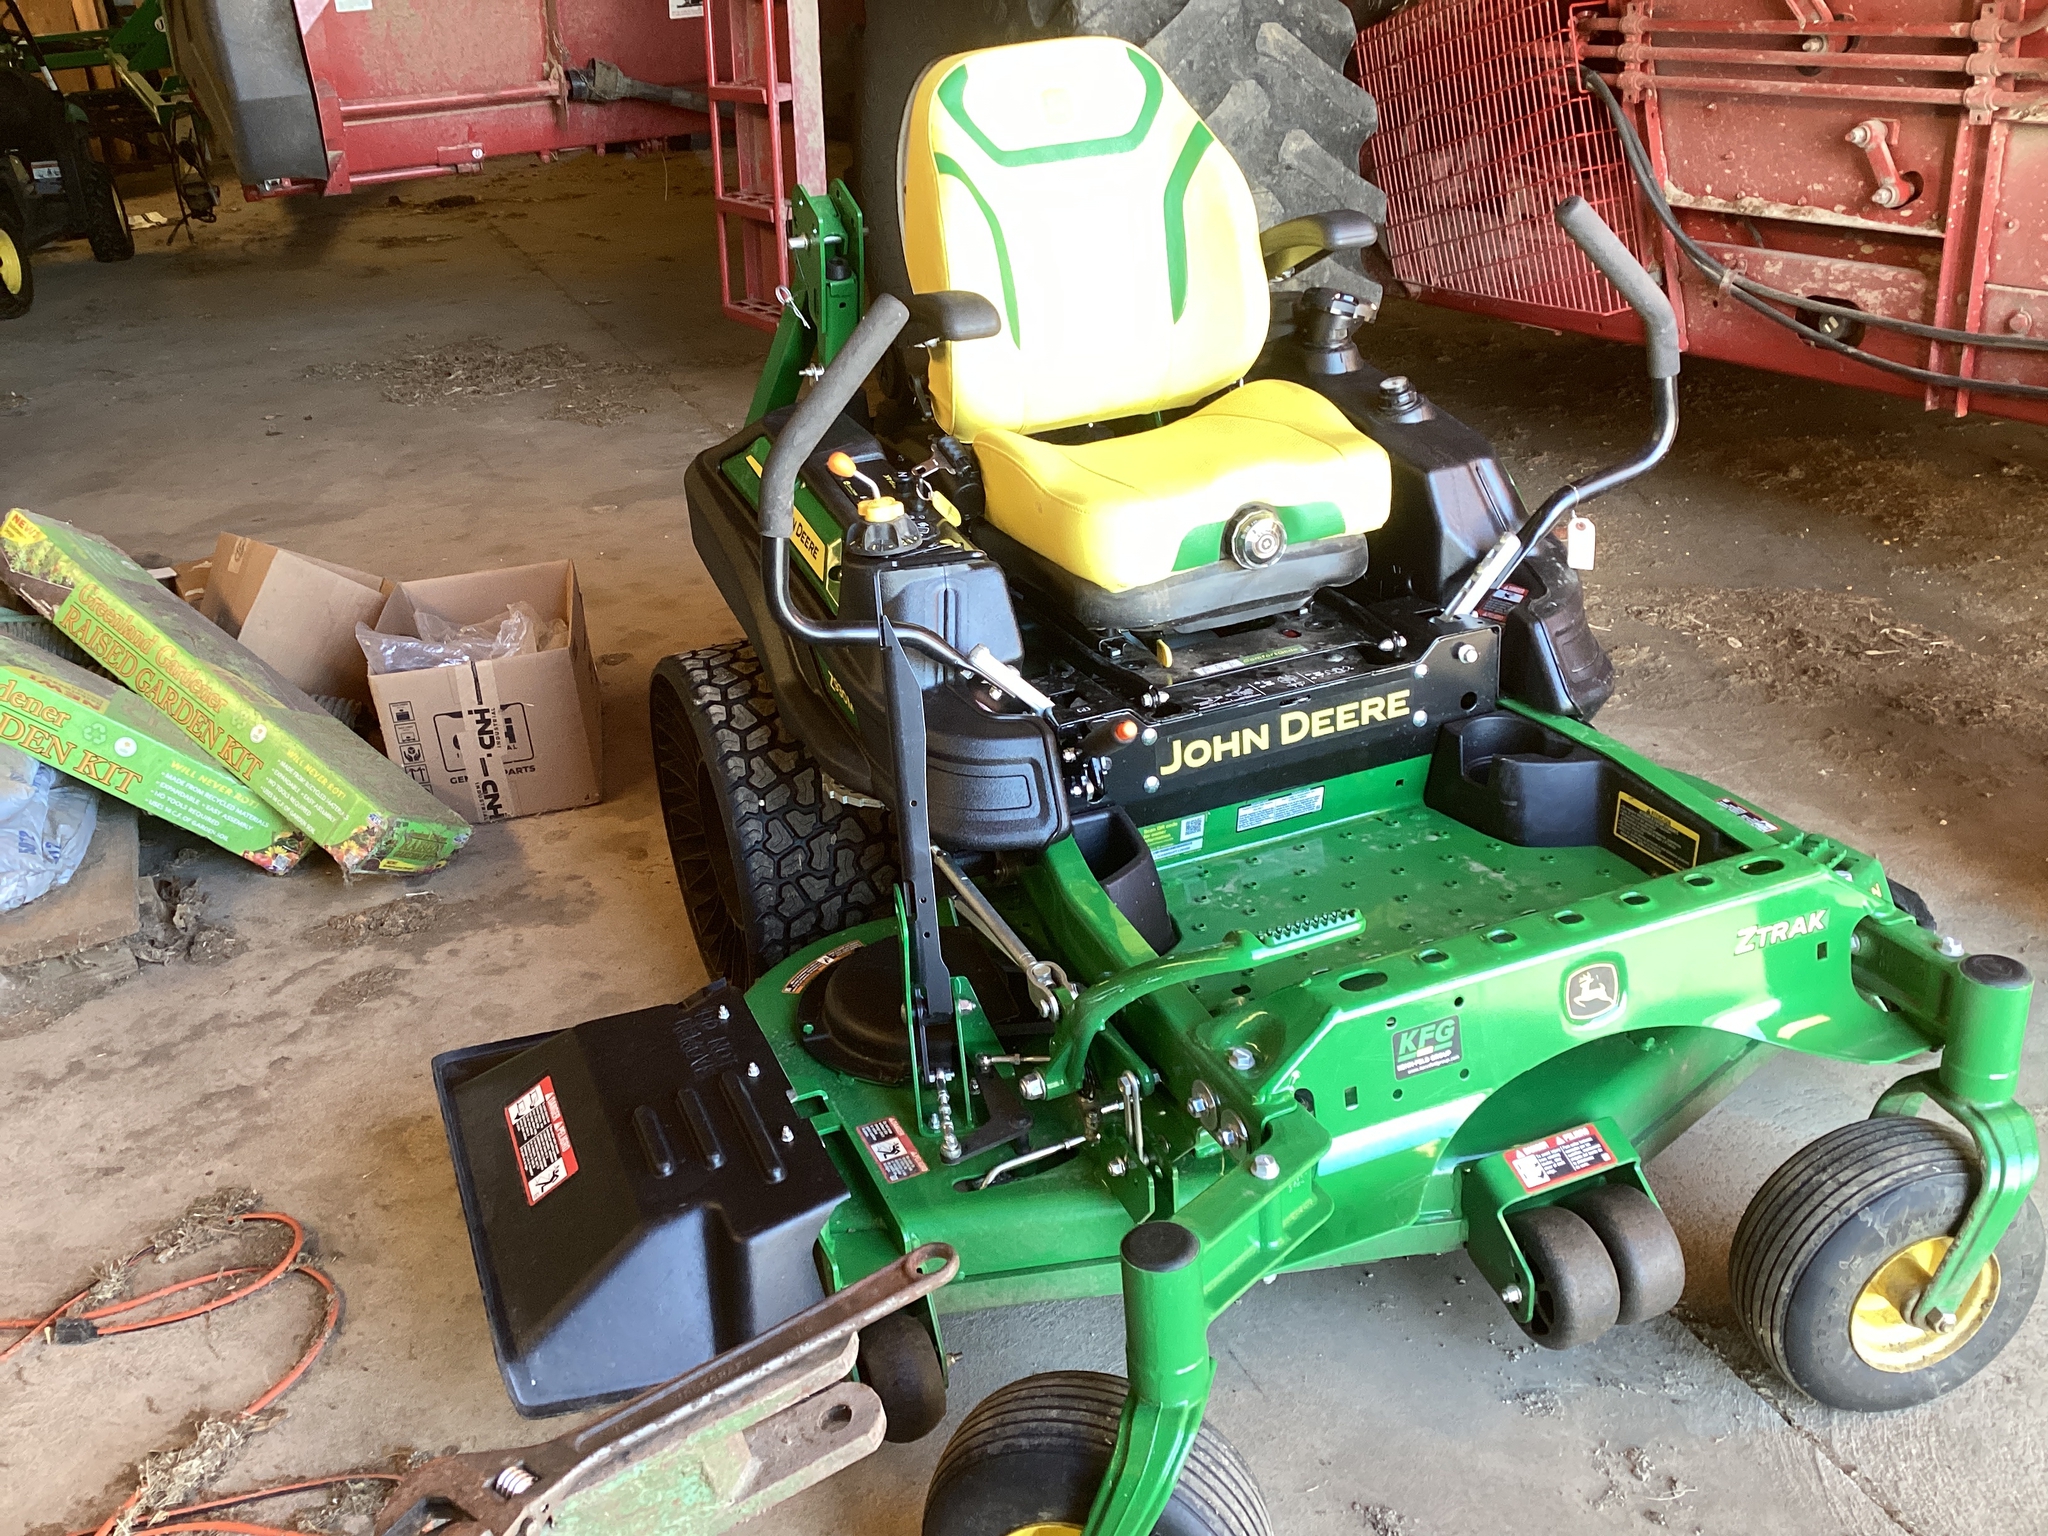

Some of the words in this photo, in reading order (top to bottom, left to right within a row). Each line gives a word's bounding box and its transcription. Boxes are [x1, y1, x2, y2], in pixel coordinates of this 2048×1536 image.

[795, 522, 820, 560] DEERE
[78, 583, 159, 655] Greenland
[155, 645, 228, 713] Gardener
[59, 604, 139, 677] RAISED
[135, 668, 224, 750] GARDEN
[217, 735, 264, 781] KIT
[473, 708, 495, 749] CNH
[491, 707, 501, 748] INDUSTRIAL
[1159, 723, 1270, 776] JOHN
[1280, 688, 1411, 745] DEERE
[73, 750, 143, 794] KIT
[171, 760, 197, 779] WILL
[198, 774, 233, 796] NEVER
[233, 792, 260, 810] ROT!
[280, 760, 294, 774] MADE
[292, 771, 306, 784] FROM
[304, 781, 327, 801] RECYCLED
[286, 749, 305, 767] WILL
[304, 763, 328, 786] NEVER
[327, 782, 347, 800] ROT!
[154, 790, 166, 799] NO
[166, 796, 188, 810] TOOLS
[188, 806, 220, 827] REQUIRED
[159, 781, 201, 806] EXPANDABLE
[205, 804, 223, 817] EASY
[222, 813, 254, 831] ASSEMBLY
[165, 773, 185, 786] MADE
[185, 781, 204, 795] FROM
[204, 791, 235, 811] RECYCLED
[235, 807, 270, 828] MATERIALS
[262, 787, 274, 799] USES
[289, 810, 308, 827] GARDEN
[306, 823, 316, 835] SOIL
[267, 778, 277, 787] NO
[276, 784, 291, 799] TOOLS
[289, 796, 312, 817] REQUIRED
[273, 769, 301, 794] EXPANDABLE
[303, 793, 316, 806] EASY
[314, 803, 336, 823] ASSEMBLY
[475, 781, 489, 821] INDUSTRIAL
[482, 779, 505, 822] CNH
[148, 799, 164, 811] USES
[182, 814, 192, 823] OF
[191, 819, 216, 836] GARDEN
[216, 831, 229, 842] SOIL
[1733, 907, 1829, 956] ZTRAK
[1399, 1019, 1455, 1055] KFG
[547, 1098, 561, 1122] DANGER
[556, 1126, 571, 1153] PELIGRO
